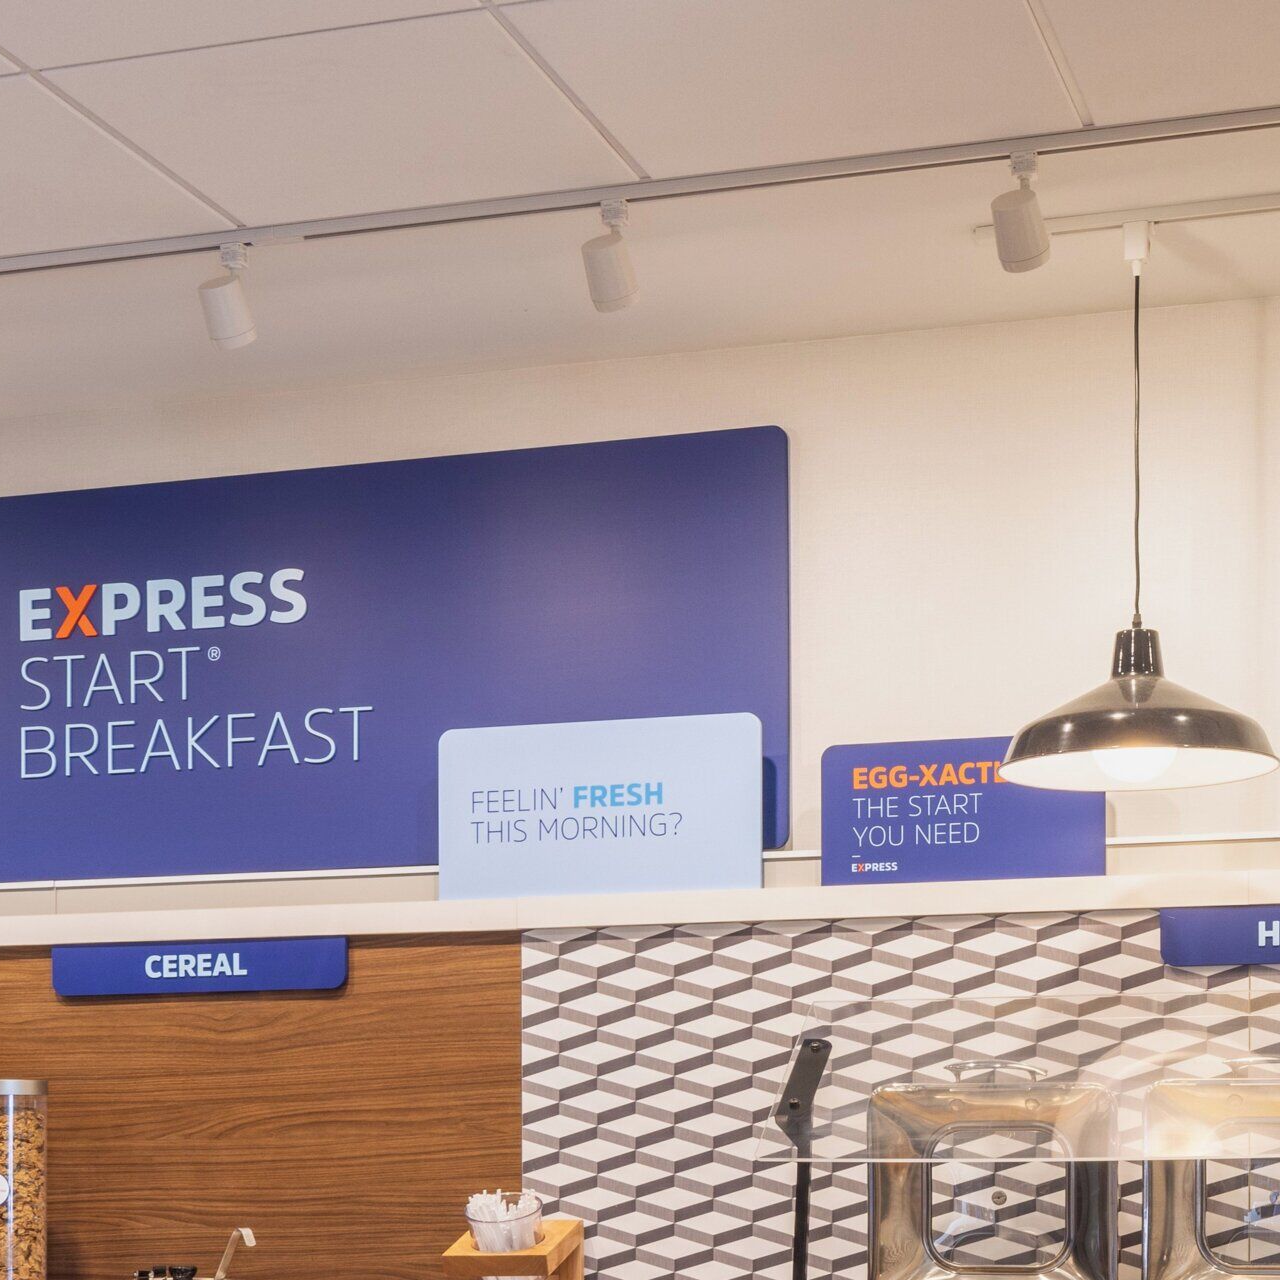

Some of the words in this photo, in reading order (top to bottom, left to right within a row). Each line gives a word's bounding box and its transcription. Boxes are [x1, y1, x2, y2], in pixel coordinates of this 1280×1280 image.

[19, 568, 307, 642] EXPRESS
[20, 706, 373, 779] BREAKFAST
[852, 761, 1010, 790] EGG-XACTL
[573, 782, 663, 808] FRESH
[852, 796, 899, 819] THE
[908, 793, 983, 817] START
[470, 819, 528, 844] THIS
[538, 812, 683, 842] MORNING?
[852, 825, 904, 847] YOU
[915, 822, 980, 845] NEED
[851, 861, 898, 872] EXPRESS
[144, 952, 248, 979] CEREAL
